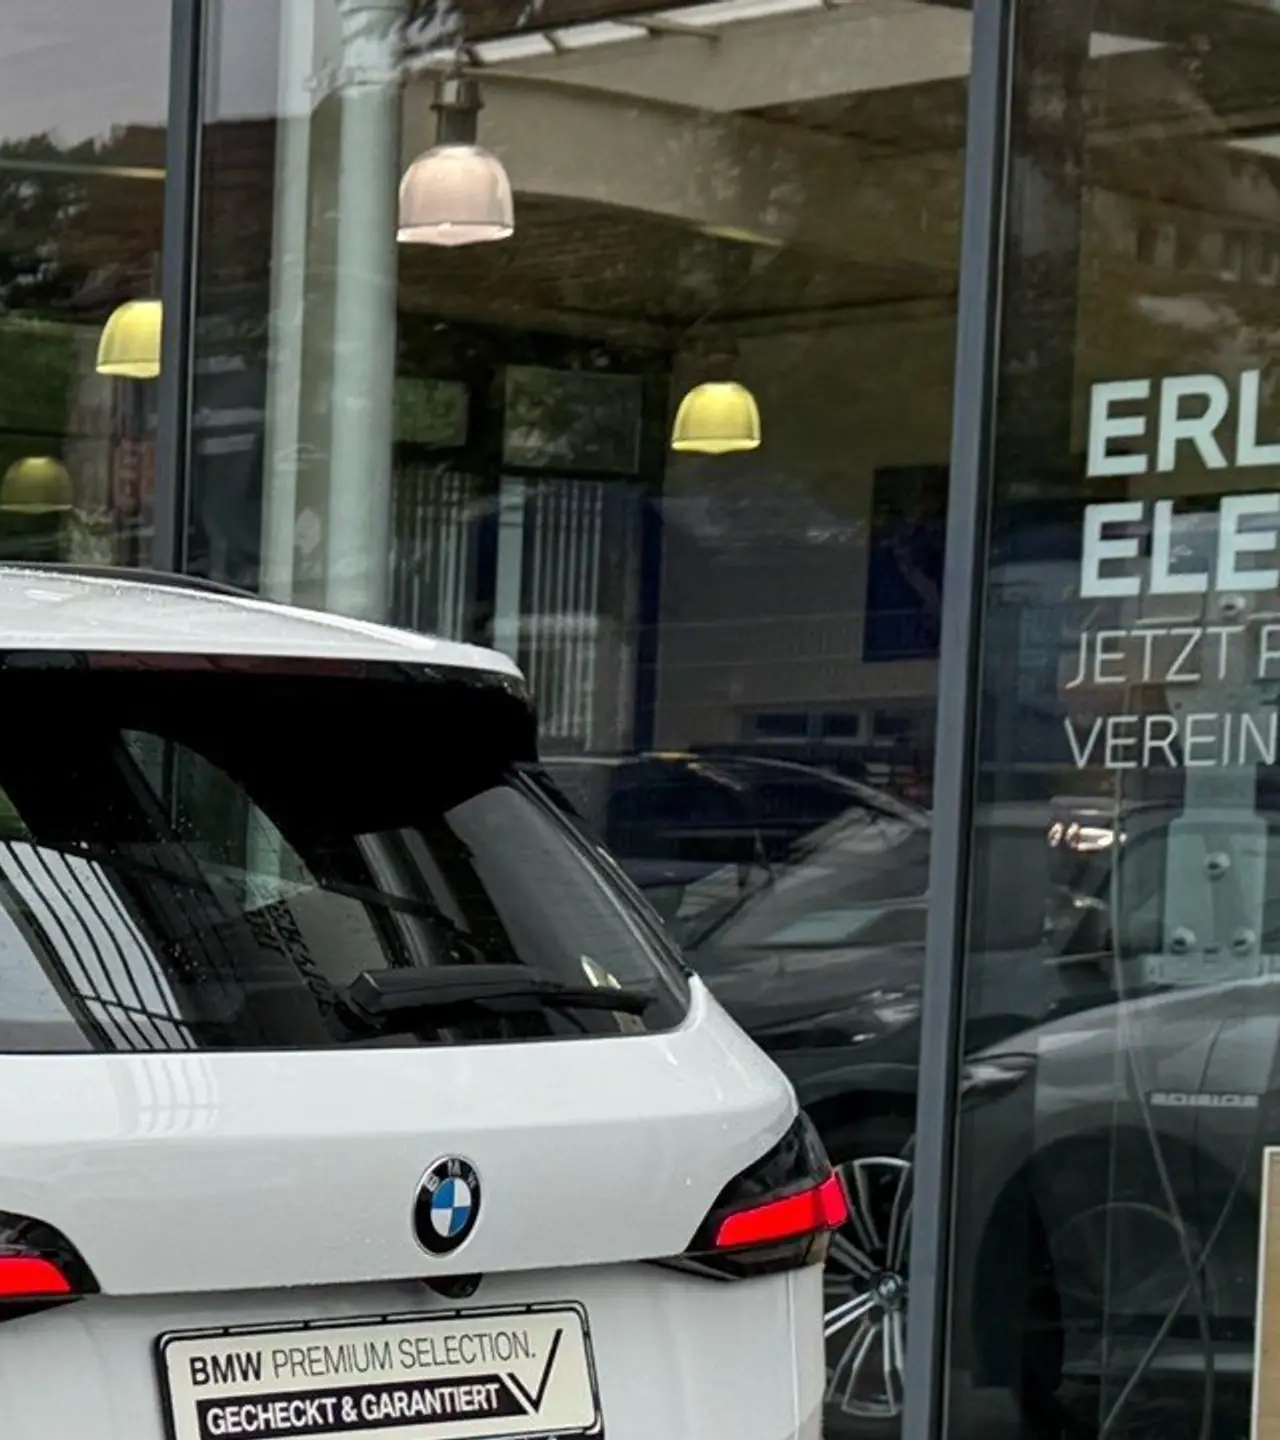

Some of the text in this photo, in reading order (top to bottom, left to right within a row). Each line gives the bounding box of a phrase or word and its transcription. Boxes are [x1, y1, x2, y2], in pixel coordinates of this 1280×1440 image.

[1086, 369, 1280, 478] ERL
[1080, 493, 1280, 598] ELE
[1064, 625, 1247, 689] JETZT
[1064, 711, 1278, 769] VEREIN
[189, 1330, 537, 1386] BMW PREMIUM SELECTION.
[206, 1384, 501, 1436] GECHECKT & GARANTIERT
